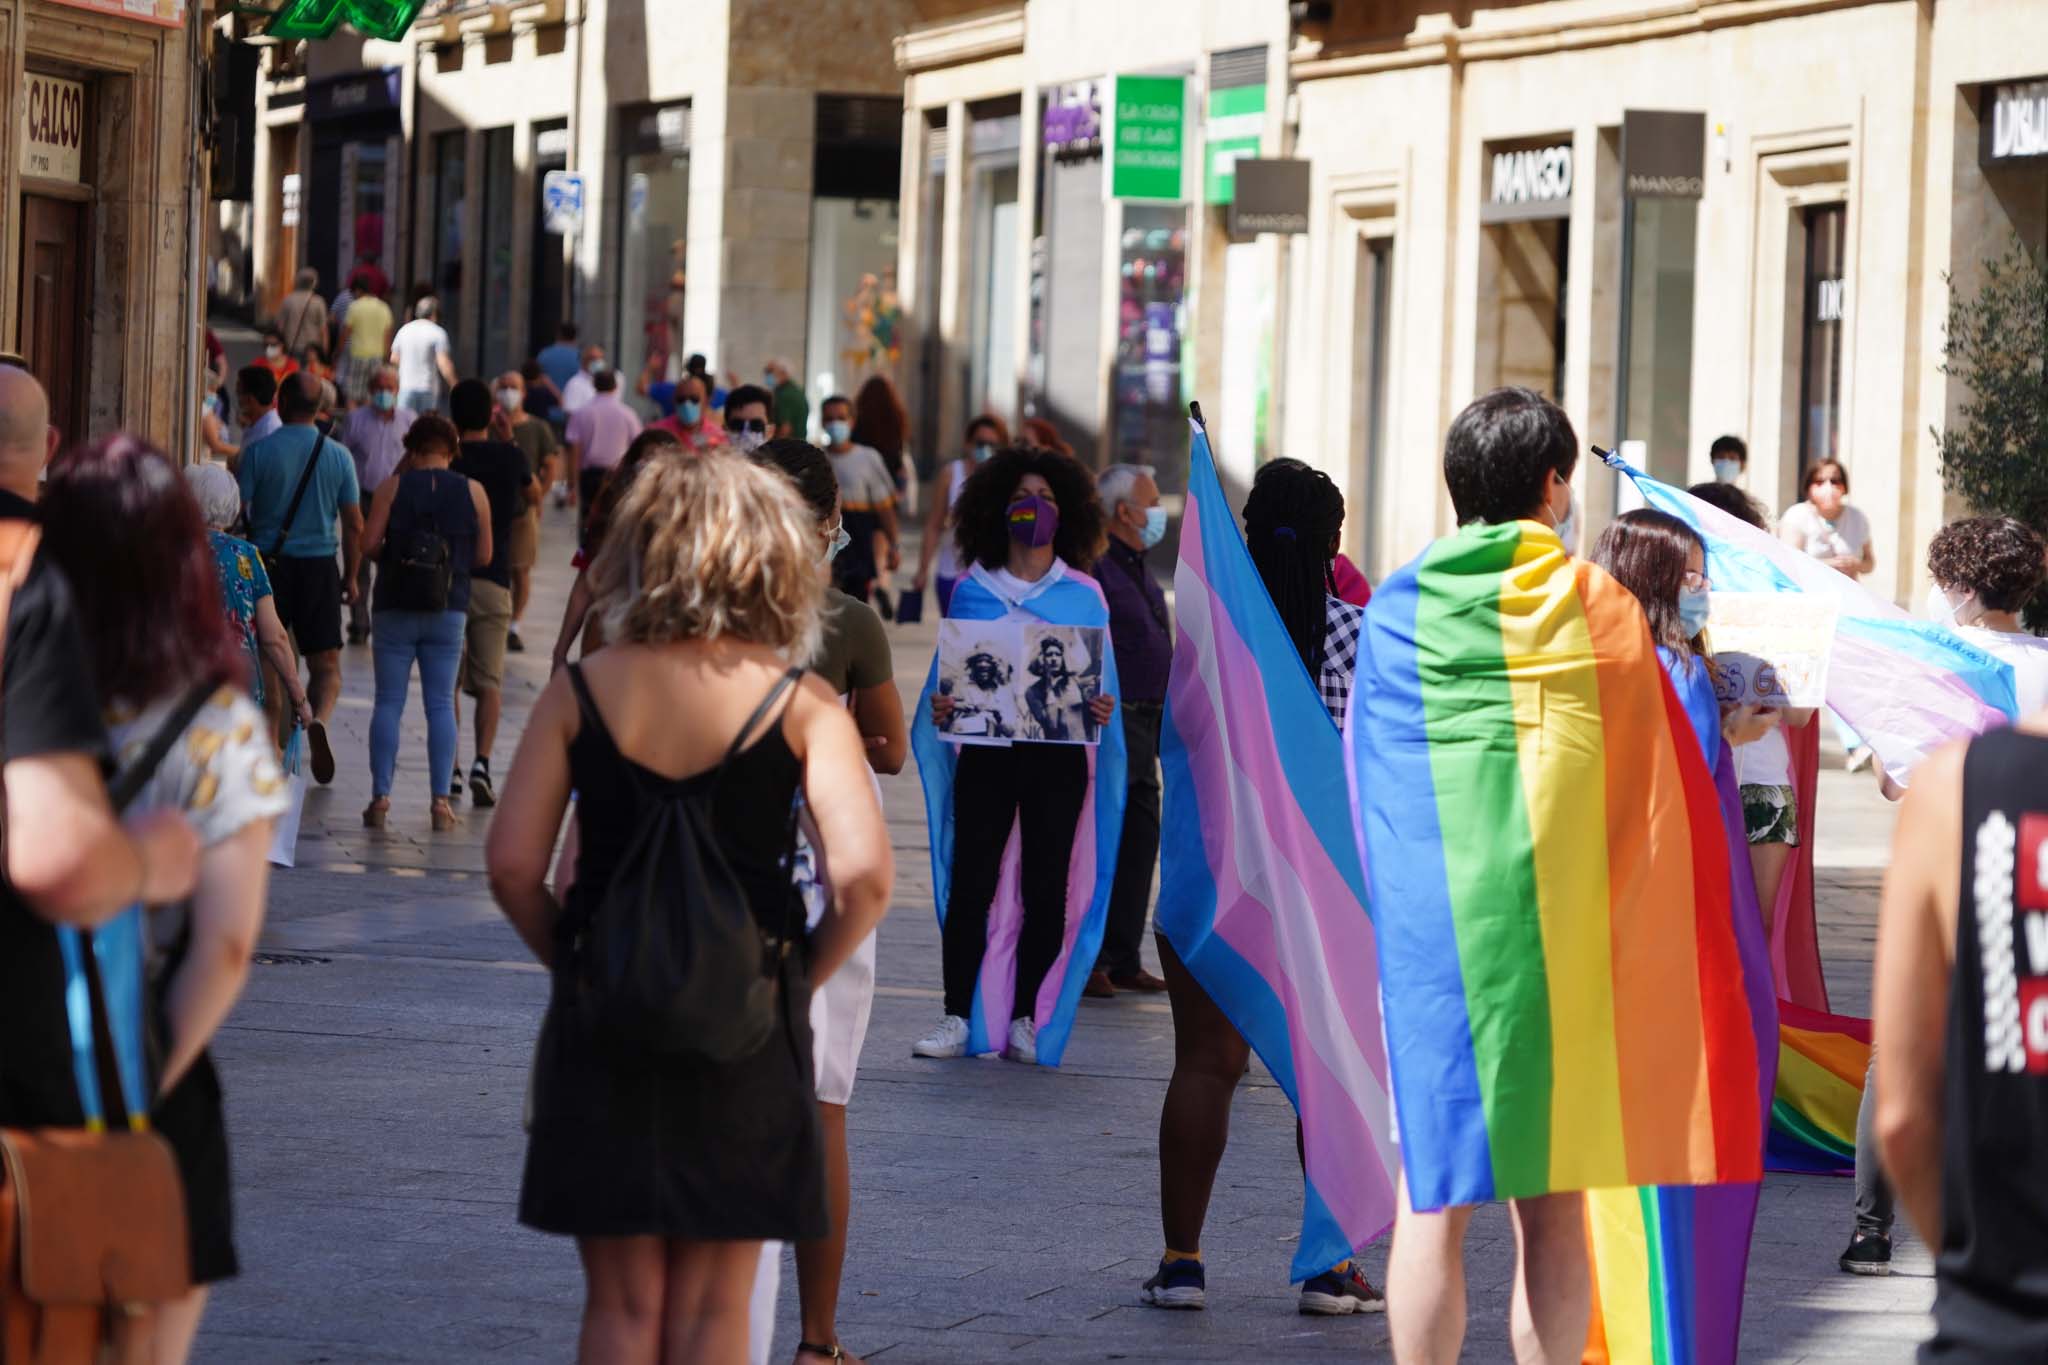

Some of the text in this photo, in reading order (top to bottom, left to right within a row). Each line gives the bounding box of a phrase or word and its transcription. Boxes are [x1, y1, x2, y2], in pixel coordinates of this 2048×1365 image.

[29, 80, 81, 149] CALCO
[1993, 97, 2048, 158] DRU
[1491, 145, 1572, 204] MANGO
[1630, 175, 1702, 193] MANGO
